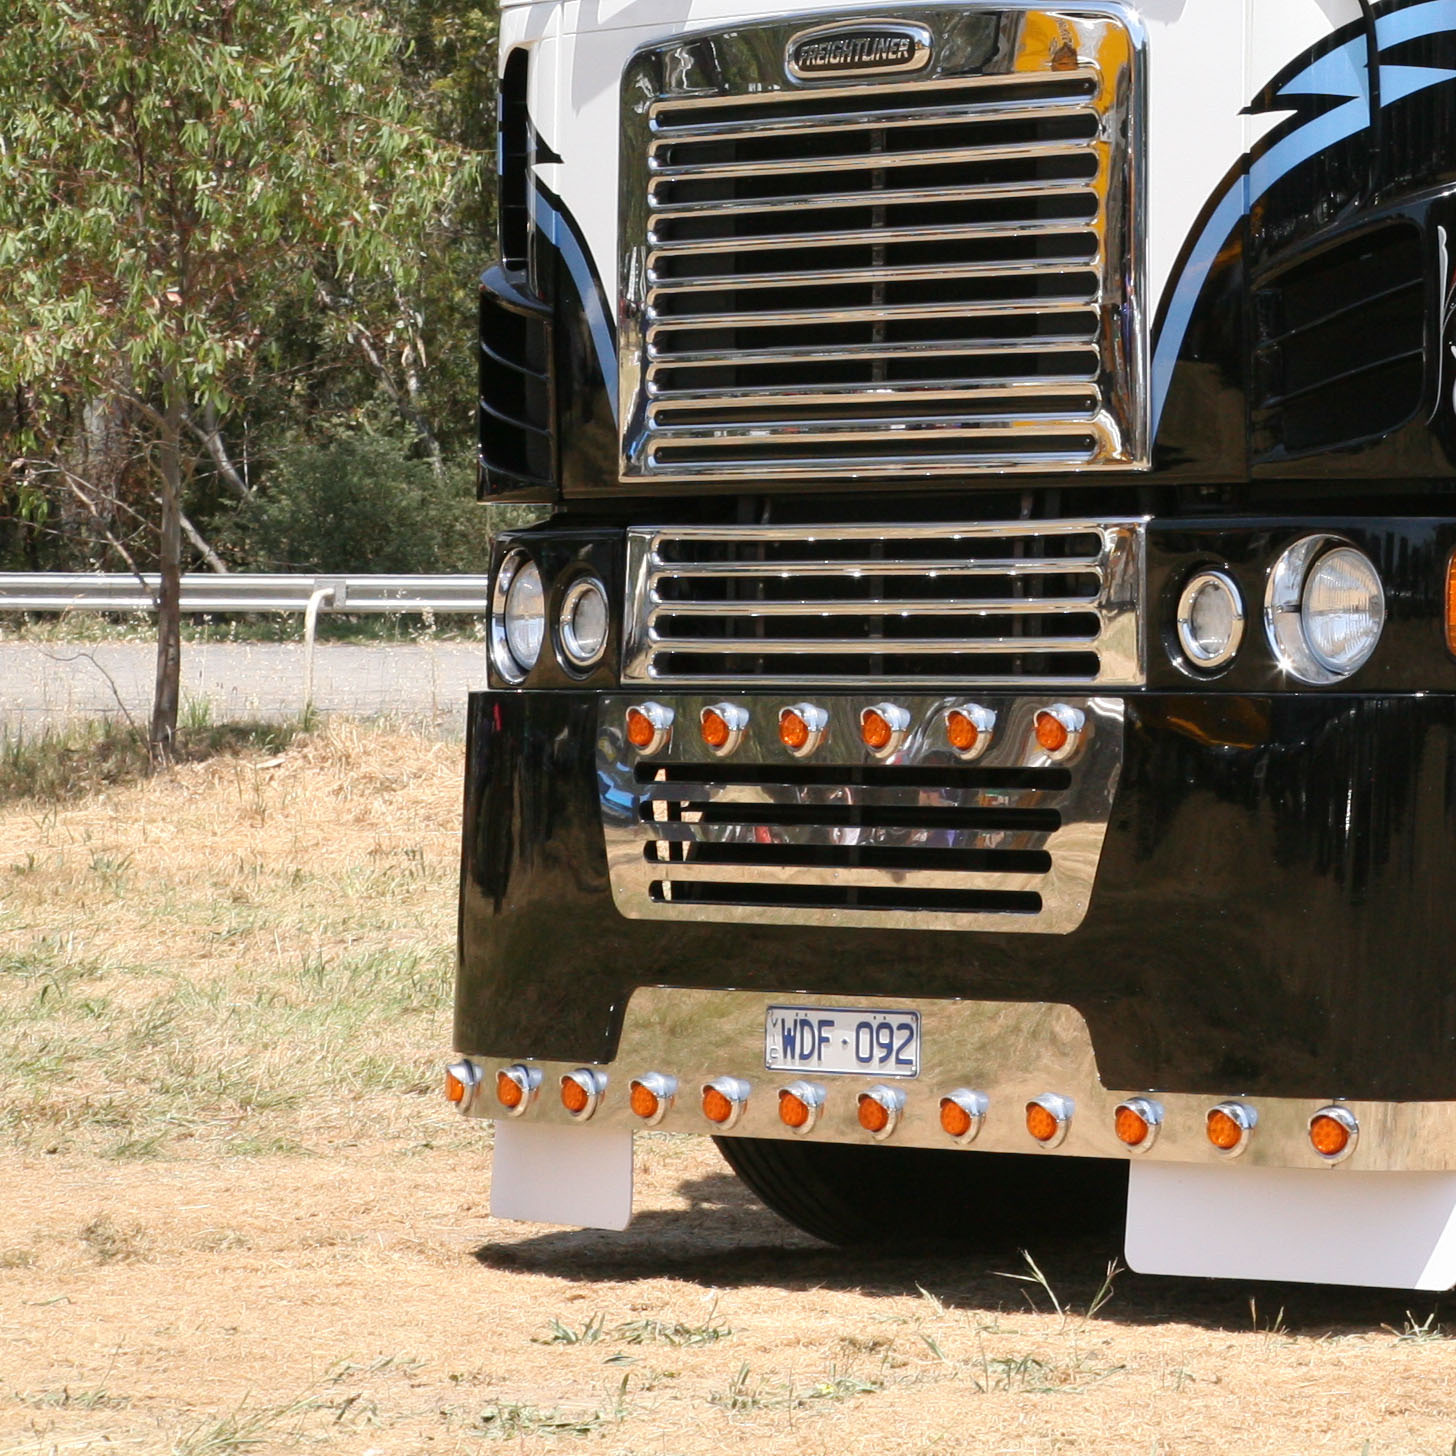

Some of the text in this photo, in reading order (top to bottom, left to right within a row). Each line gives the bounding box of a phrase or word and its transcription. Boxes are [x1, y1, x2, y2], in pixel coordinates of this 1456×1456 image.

[798, 37, 911, 67] FREIGHTLINER
[769, 1017, 779, 1059] VIC
[781, 1018, 914, 1065] WDF 092
